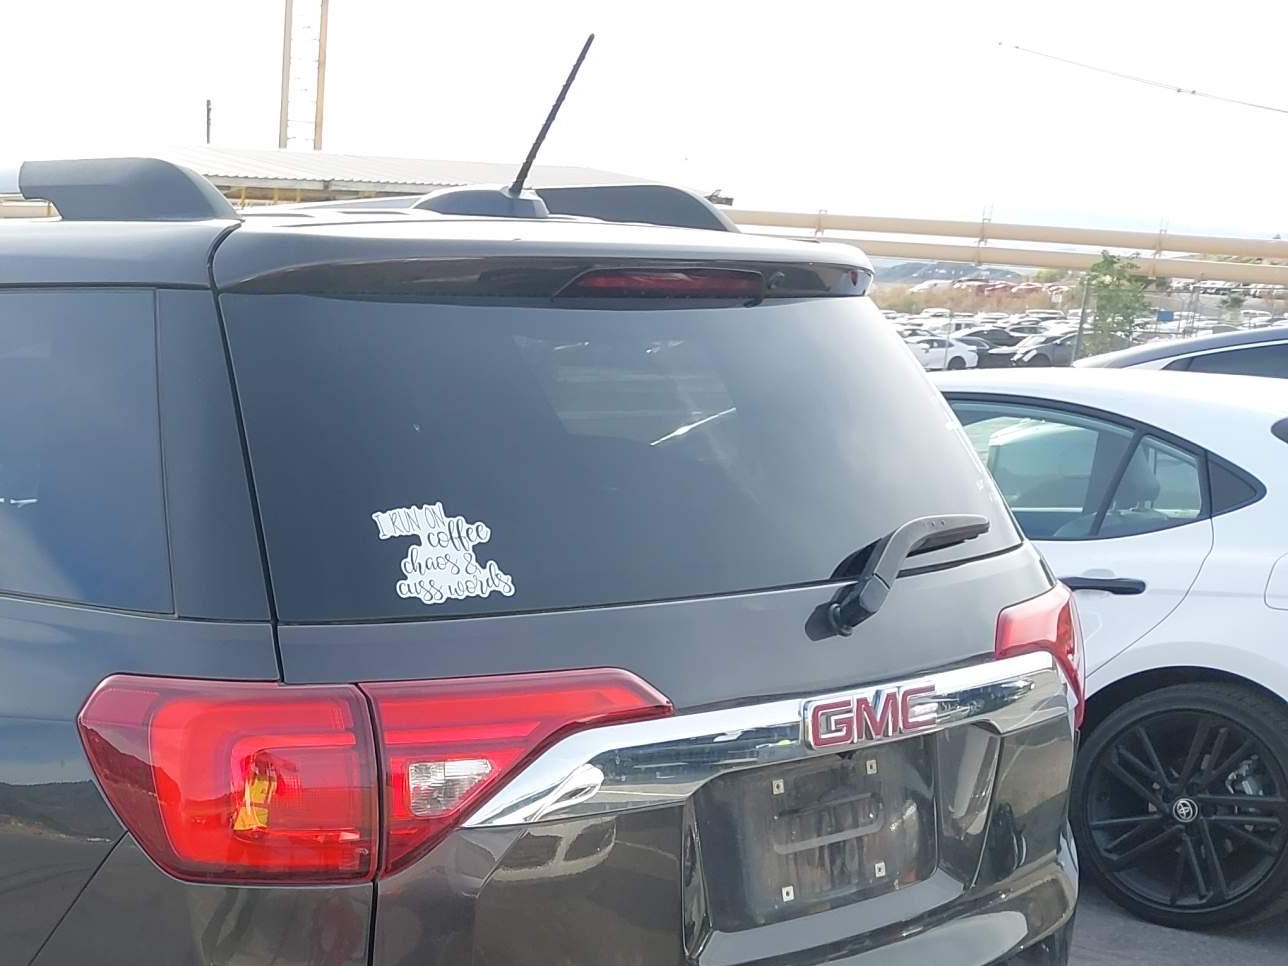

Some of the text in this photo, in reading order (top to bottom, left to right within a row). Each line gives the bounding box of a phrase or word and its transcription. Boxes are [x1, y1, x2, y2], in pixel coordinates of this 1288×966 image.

[375, 503, 447, 537] I RUN ON
[427, 518, 489, 552] coffee
[403, 547, 481, 576] chaos &
[398, 562, 513, 602] cuss words
[810, 683, 938, 749] GMC
